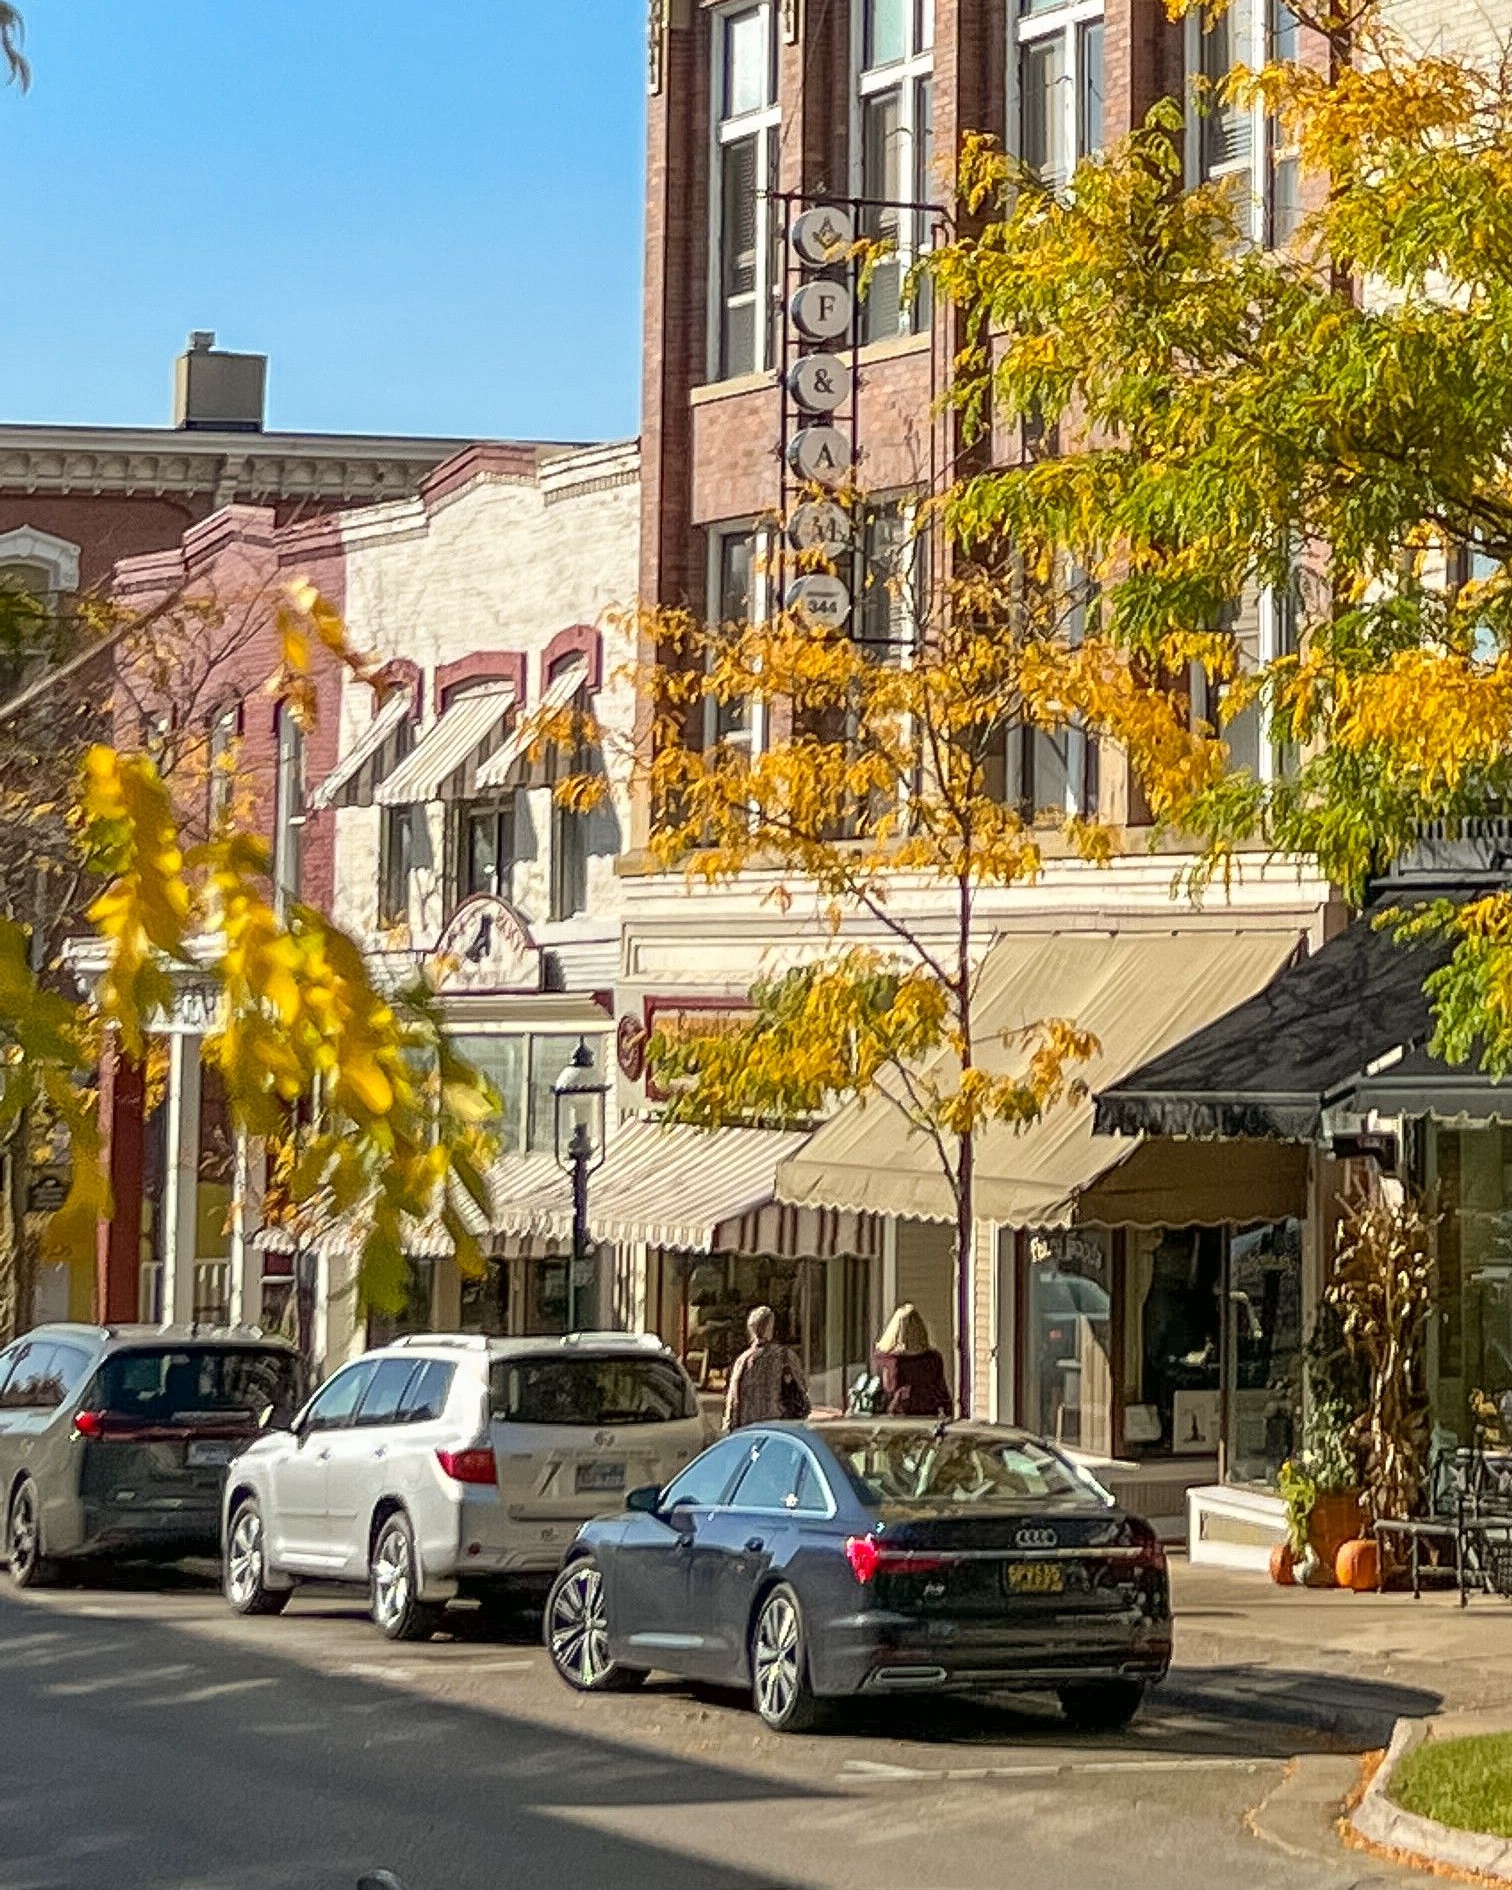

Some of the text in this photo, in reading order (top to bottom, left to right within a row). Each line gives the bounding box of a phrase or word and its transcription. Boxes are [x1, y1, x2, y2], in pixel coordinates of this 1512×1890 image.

[817, 295, 837, 322] F
[812, 368, 835, 395] &
[812, 441, 836, 468] A
